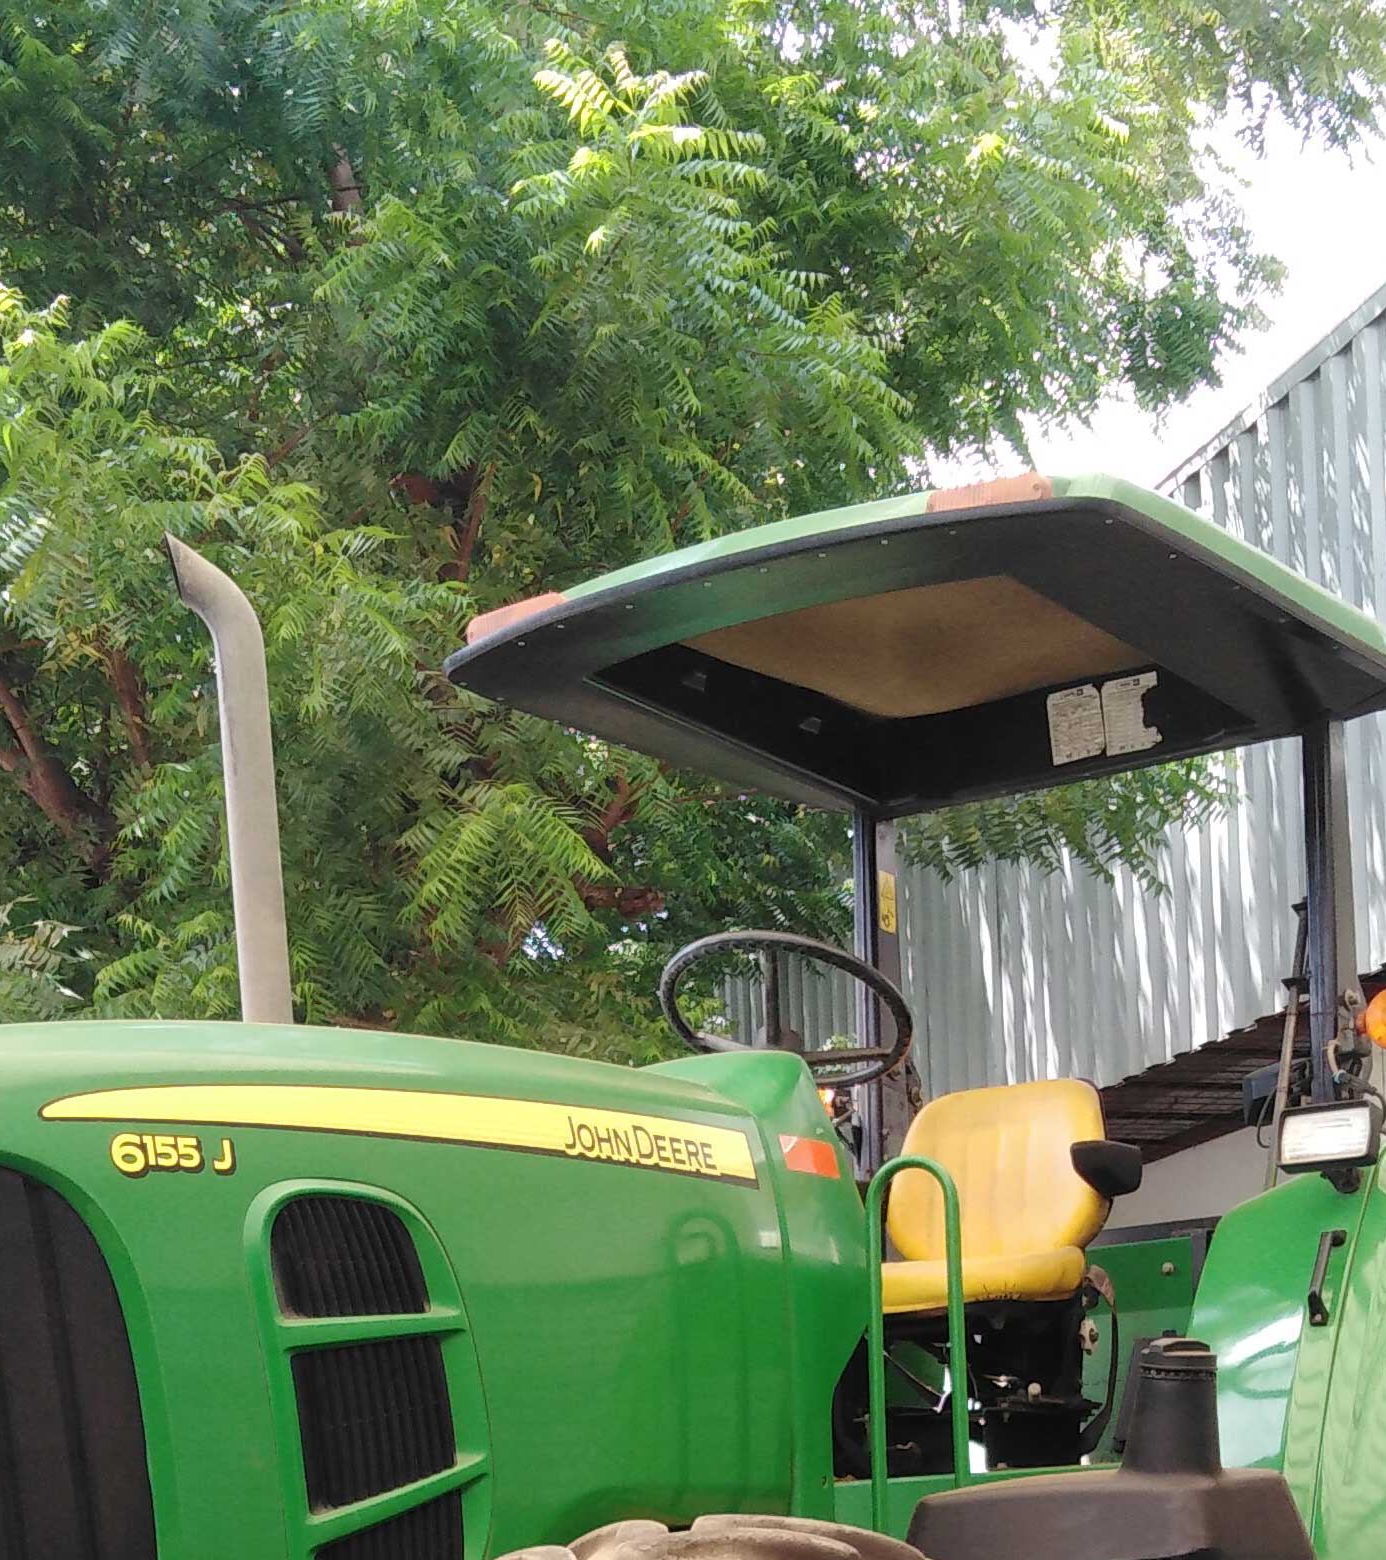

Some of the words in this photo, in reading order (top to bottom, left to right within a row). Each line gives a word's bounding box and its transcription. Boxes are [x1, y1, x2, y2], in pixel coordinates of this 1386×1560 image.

[111, 1133, 203, 1175] 6155
[213, 1139, 235, 1173] J
[565, 1116, 633, 1158] JOHN
[632, 1125, 718, 1171] DEERE
